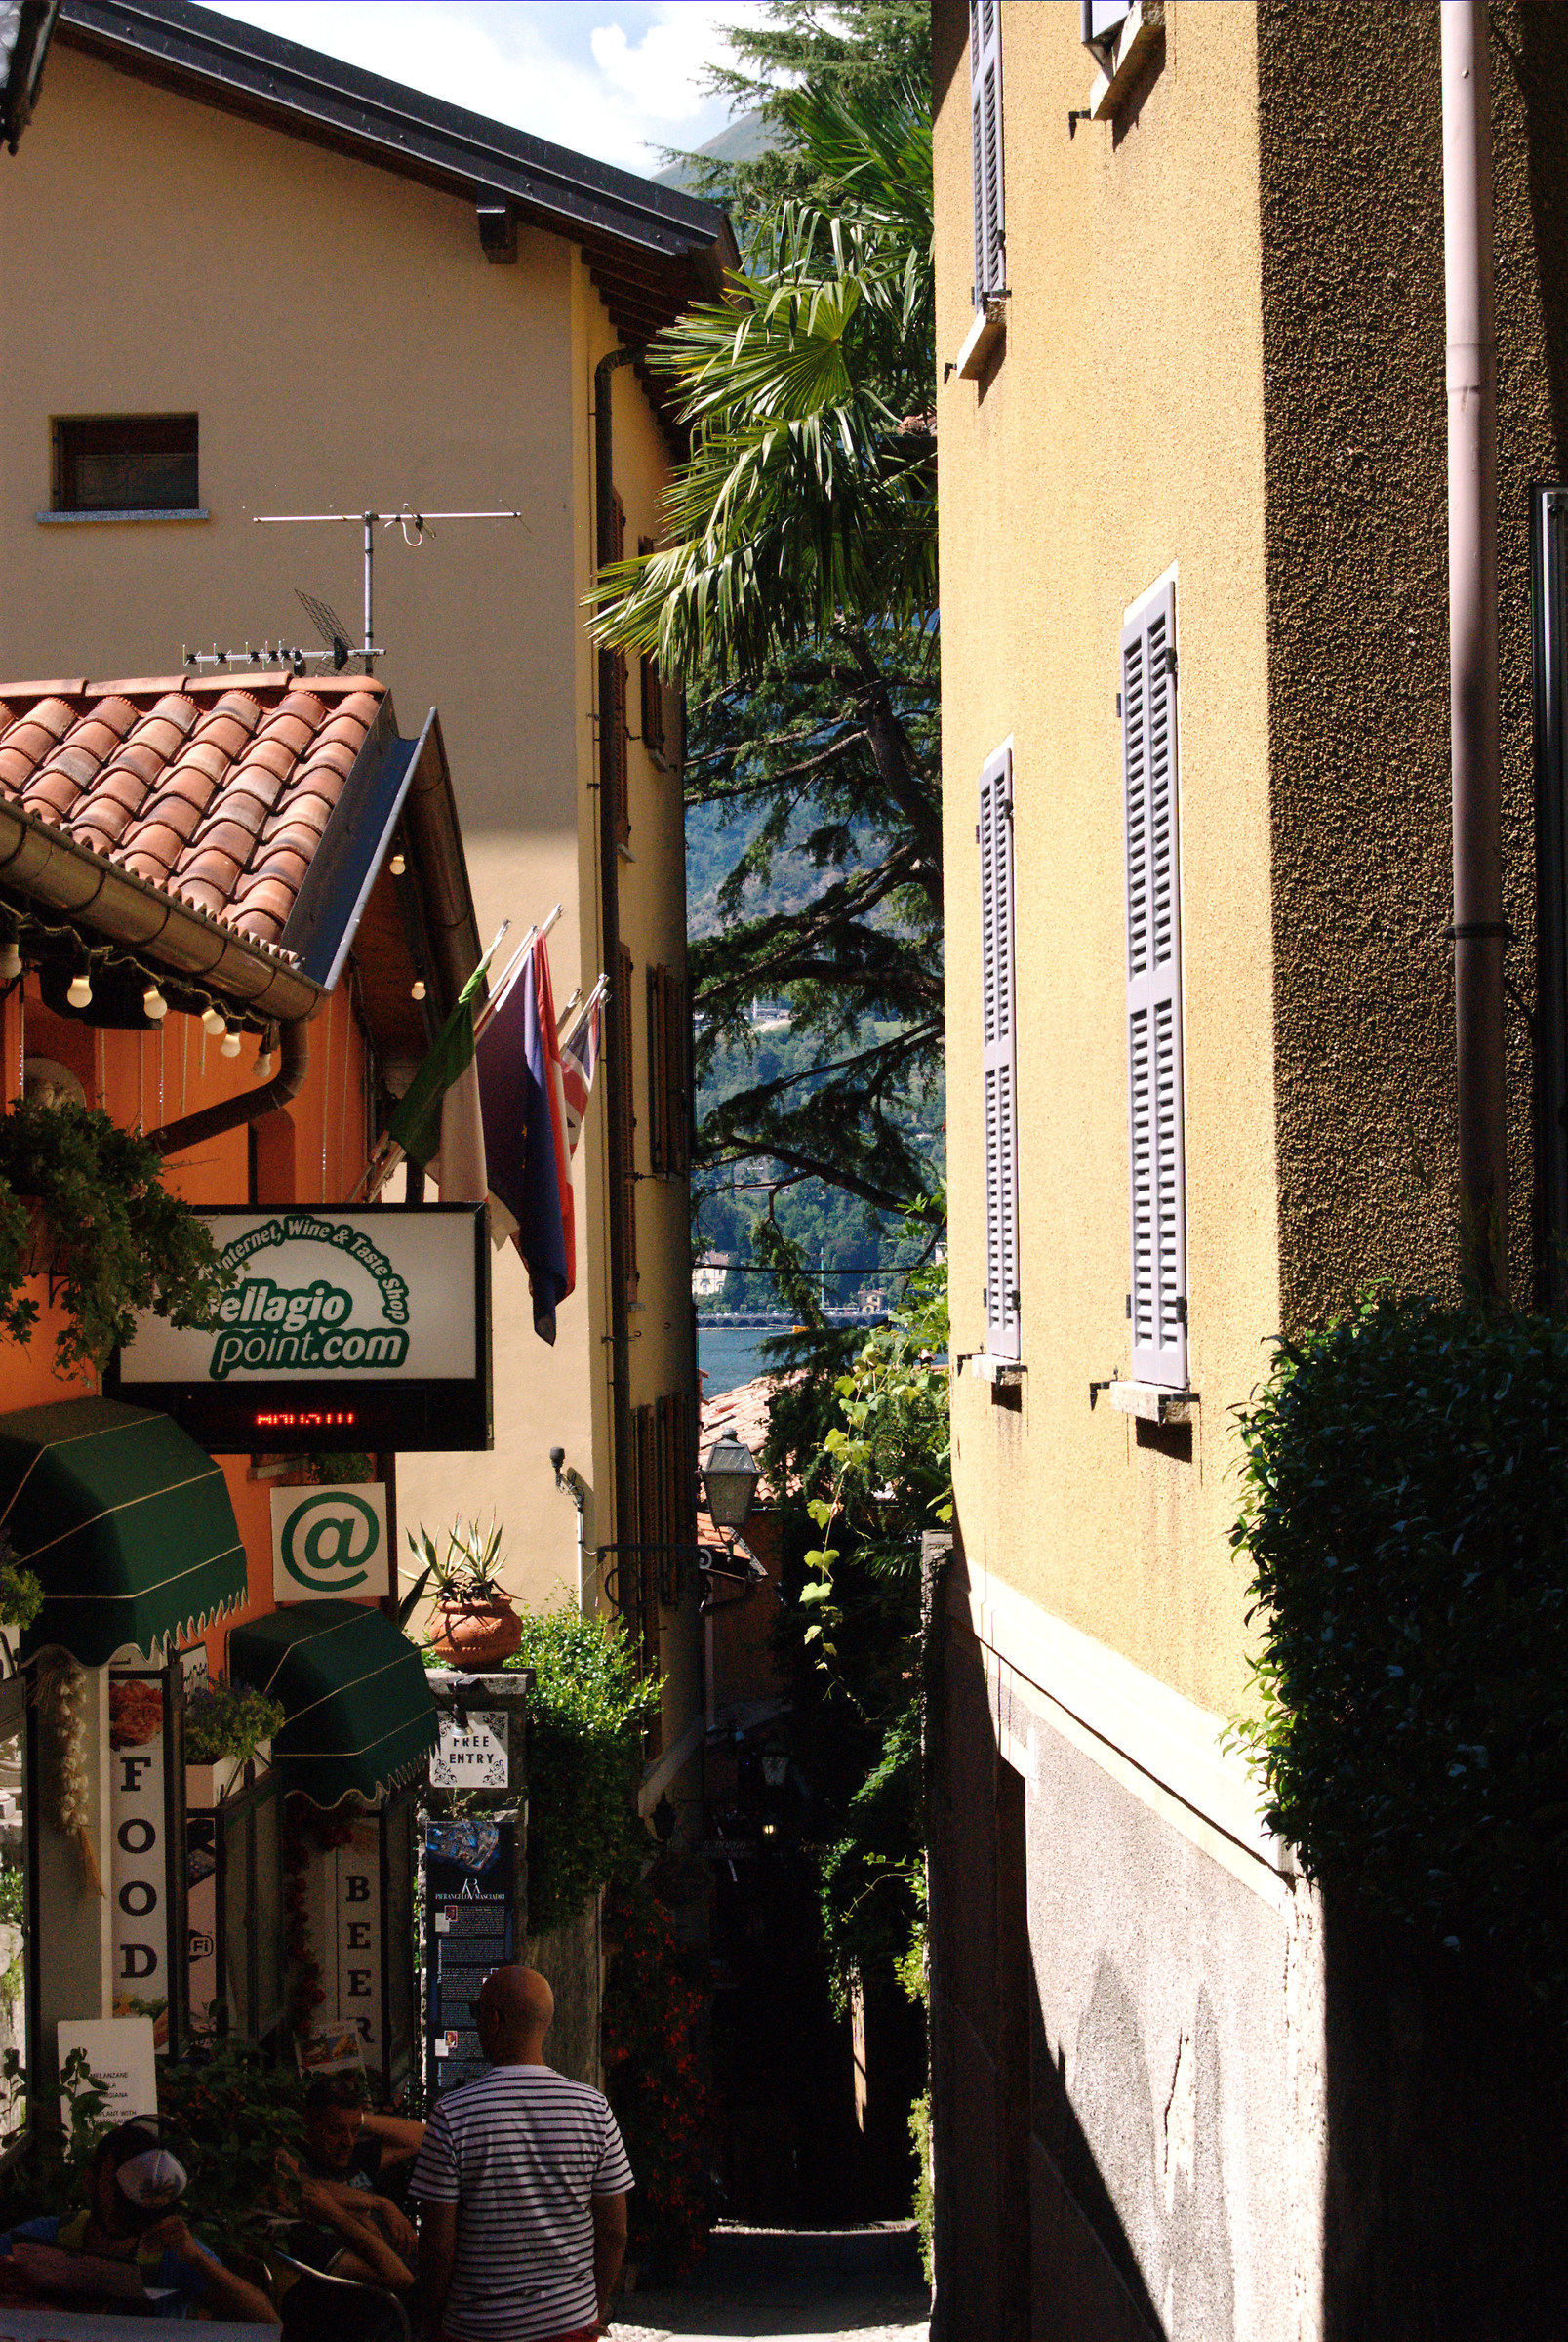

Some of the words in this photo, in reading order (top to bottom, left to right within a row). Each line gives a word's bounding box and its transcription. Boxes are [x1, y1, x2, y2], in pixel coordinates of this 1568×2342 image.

[287, 1219, 331, 1238] Wine
[333, 1228, 351, 1245] &
[349, 1236, 388, 1276] Taste
[382, 1277, 406, 1322] Shop
[209, 1285, 346, 1333] ellagio
[217, 1328, 403, 1374] point.com
[449, 1753, 495, 1764] ENTRY
[453, 1735, 490, 1748] FREE
[117, 1756, 158, 1980] FOOD
